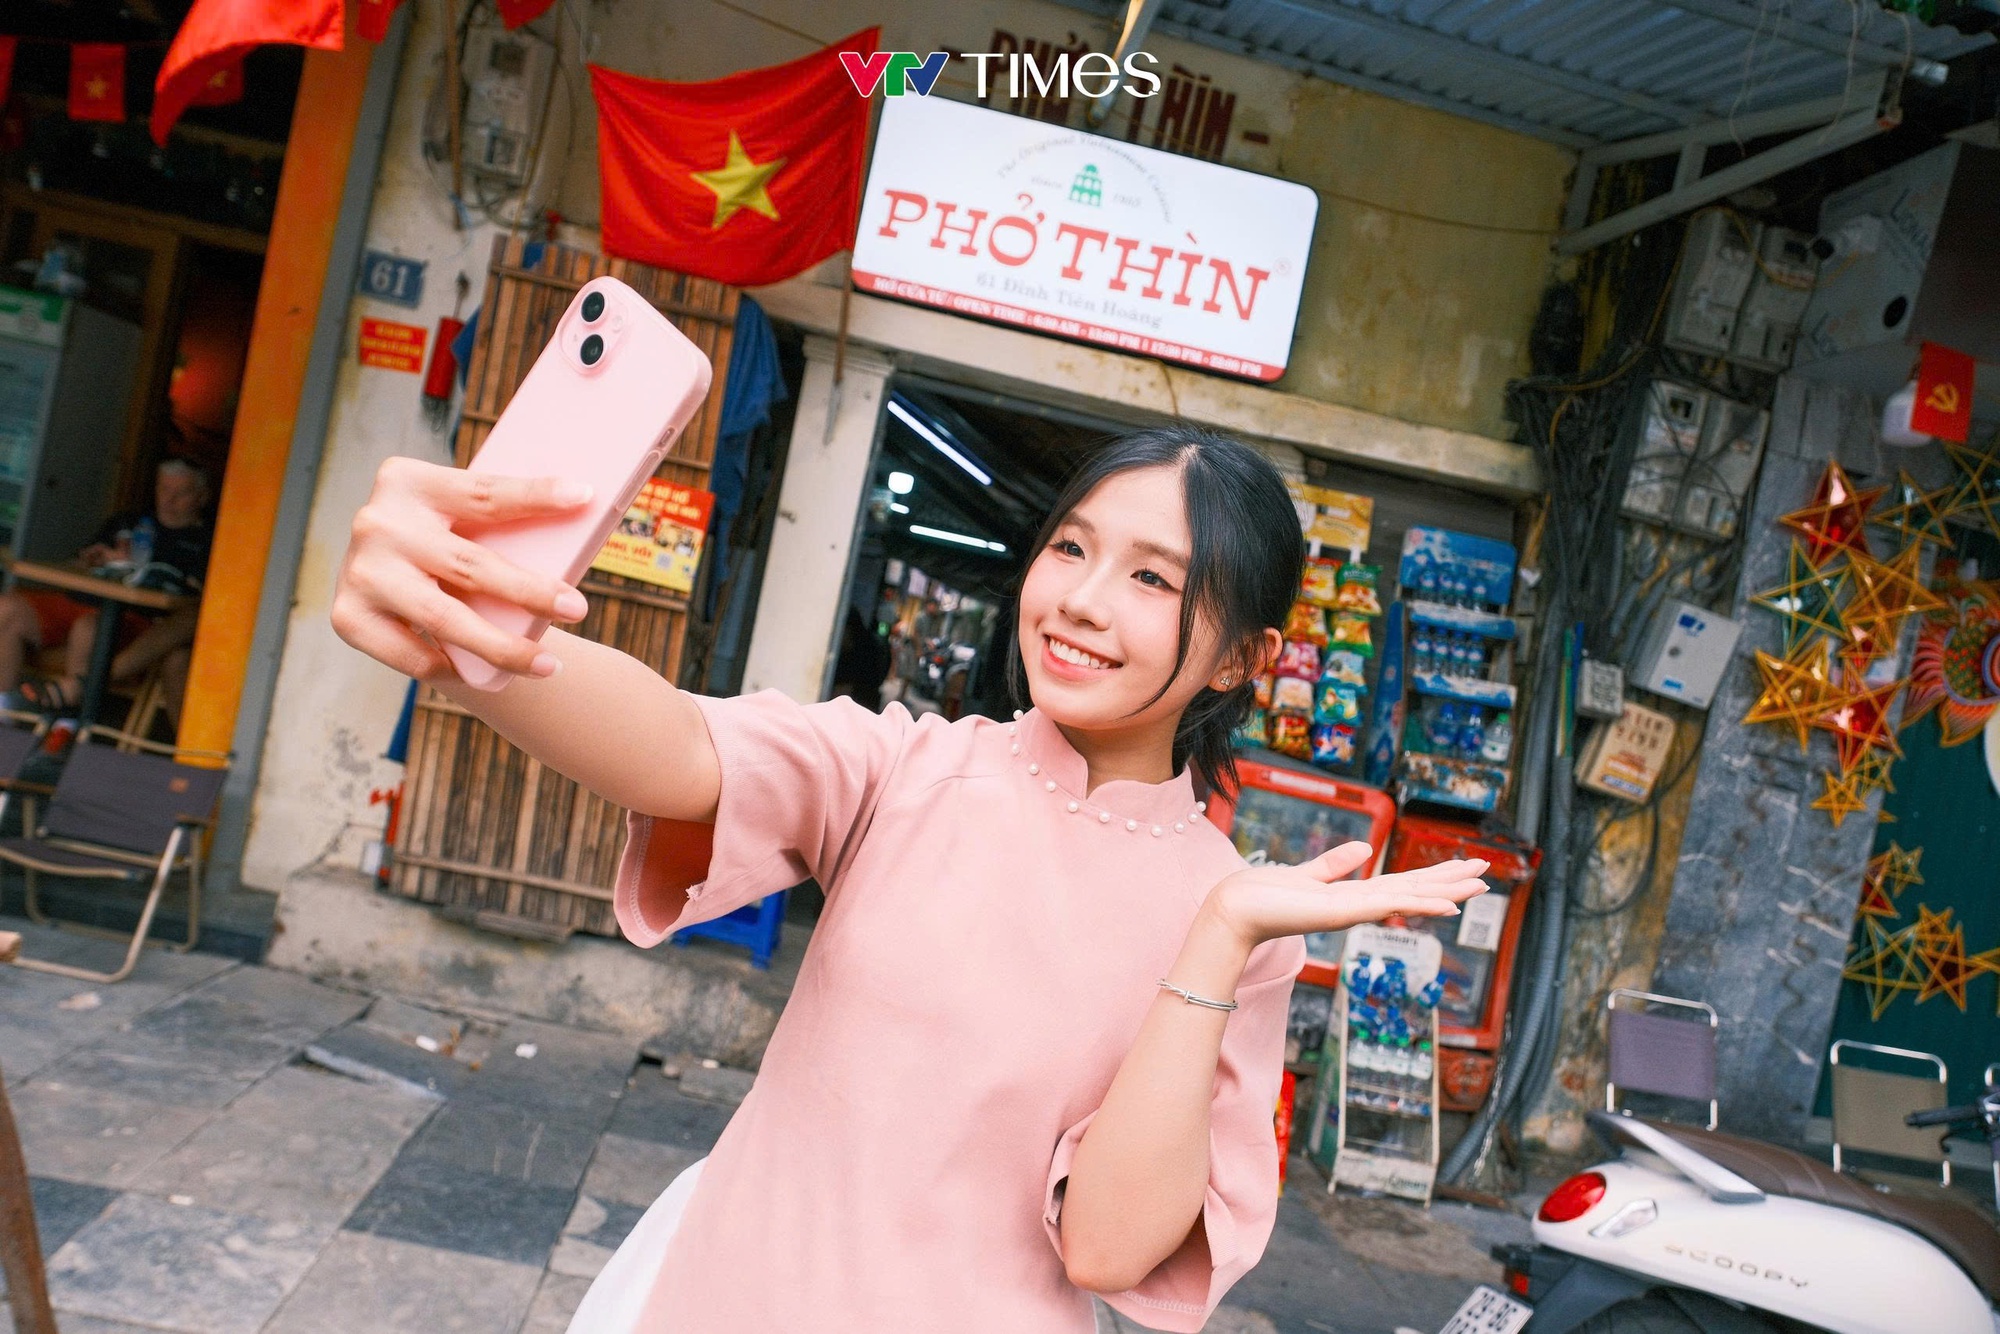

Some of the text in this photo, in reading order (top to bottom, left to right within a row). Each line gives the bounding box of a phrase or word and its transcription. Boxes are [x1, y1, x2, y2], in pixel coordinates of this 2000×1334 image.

[877, 189, 1270, 321] PHỞ THÌN
[371, 260, 410, 297] 61
[954, 296, 992, 313] OPEN
[977, 274, 996, 289] 61
[1102, 296, 1163, 331] Hoàng
[1663, 1243, 1809, 1288] SCOOPY
